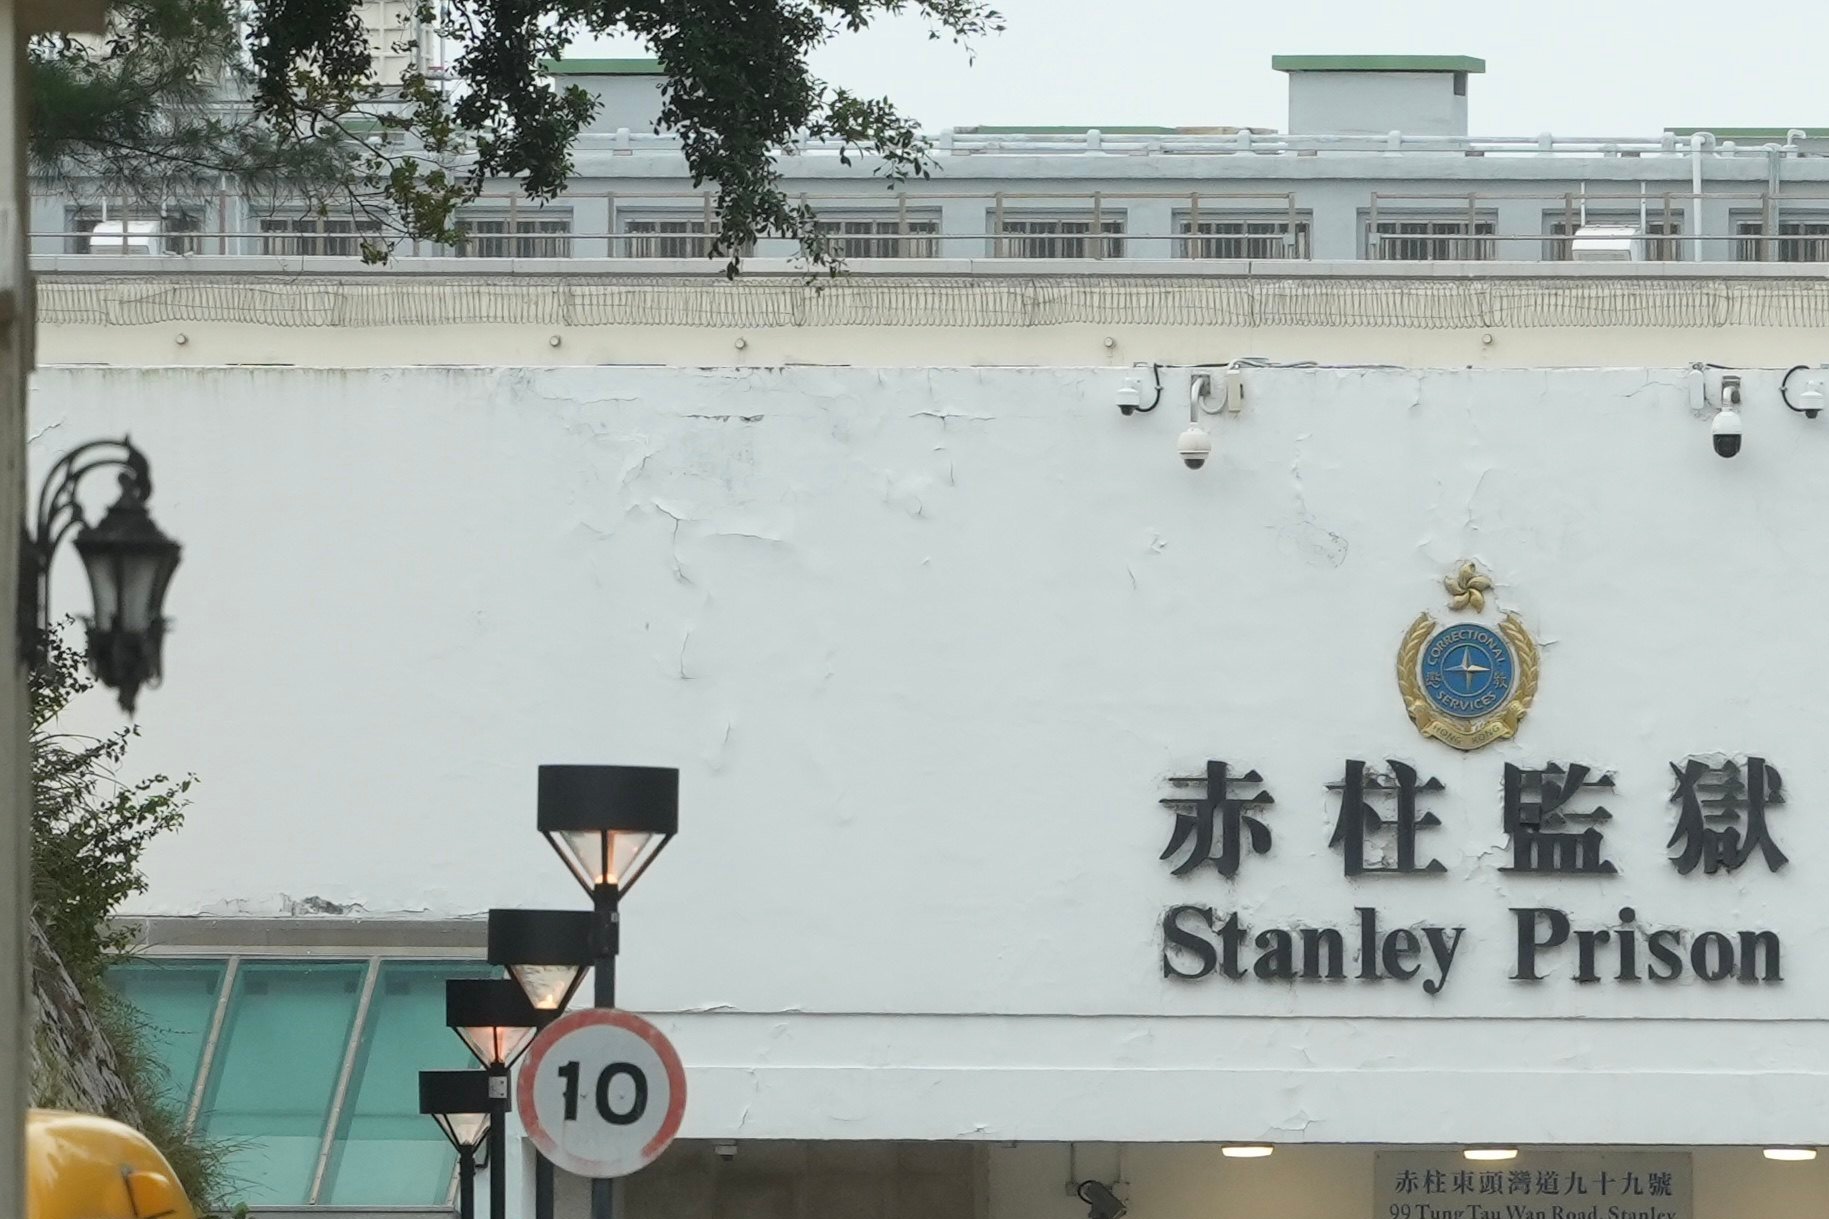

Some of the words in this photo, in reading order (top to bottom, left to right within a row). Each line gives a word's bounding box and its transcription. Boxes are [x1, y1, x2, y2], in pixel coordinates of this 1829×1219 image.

[1427, 629, 1505, 666] CORRECTIONAL
[1437, 690, 1497, 711] SERVICES
[1432, 724, 1463, 744] HONG
[1471, 724, 1500, 744] KONG
[1159, 757, 1790, 877] 赤柱監獄
[1162, 905, 1467, 995] Stanley
[1508, 906, 1785, 982] Prison
[557, 1060, 648, 1126] 10
[1394, 1168, 1673, 1197] 赤柱東頭灣道九十九號
